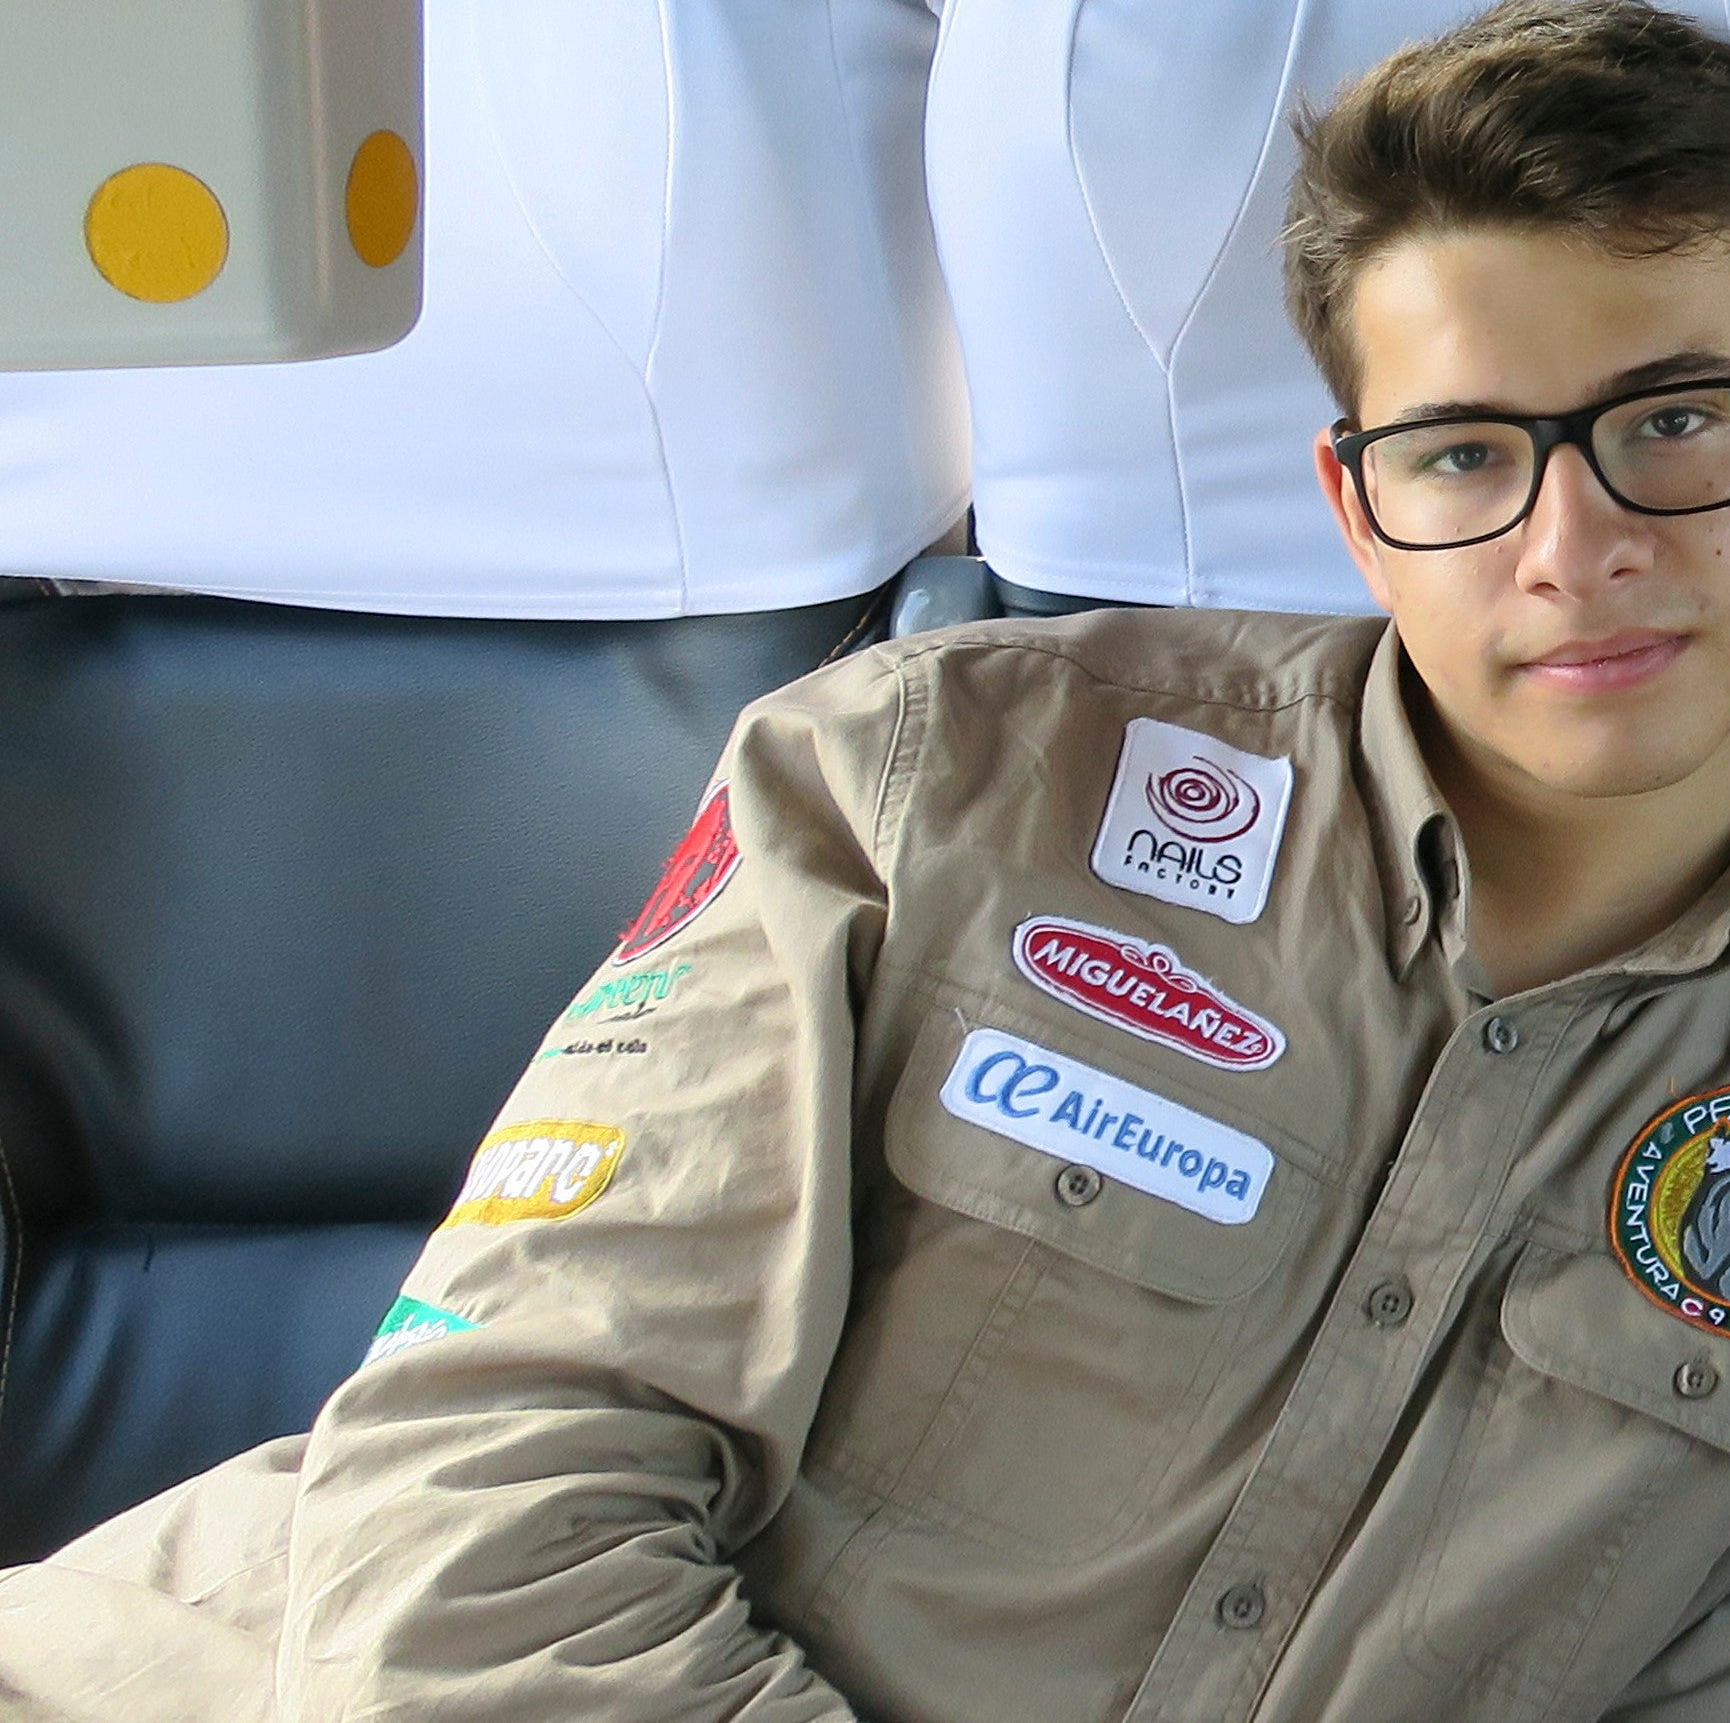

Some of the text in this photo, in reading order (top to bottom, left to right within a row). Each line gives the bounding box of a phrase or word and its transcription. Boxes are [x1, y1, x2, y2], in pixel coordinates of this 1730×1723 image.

[1123, 854, 1235, 899] FACTORY
[1032, 938, 1257, 1055] MIGUELAÑEZ
[1048, 1092, 1253, 1202] AirEuropa
[1624, 1140, 1680, 1303] AVENTURA
